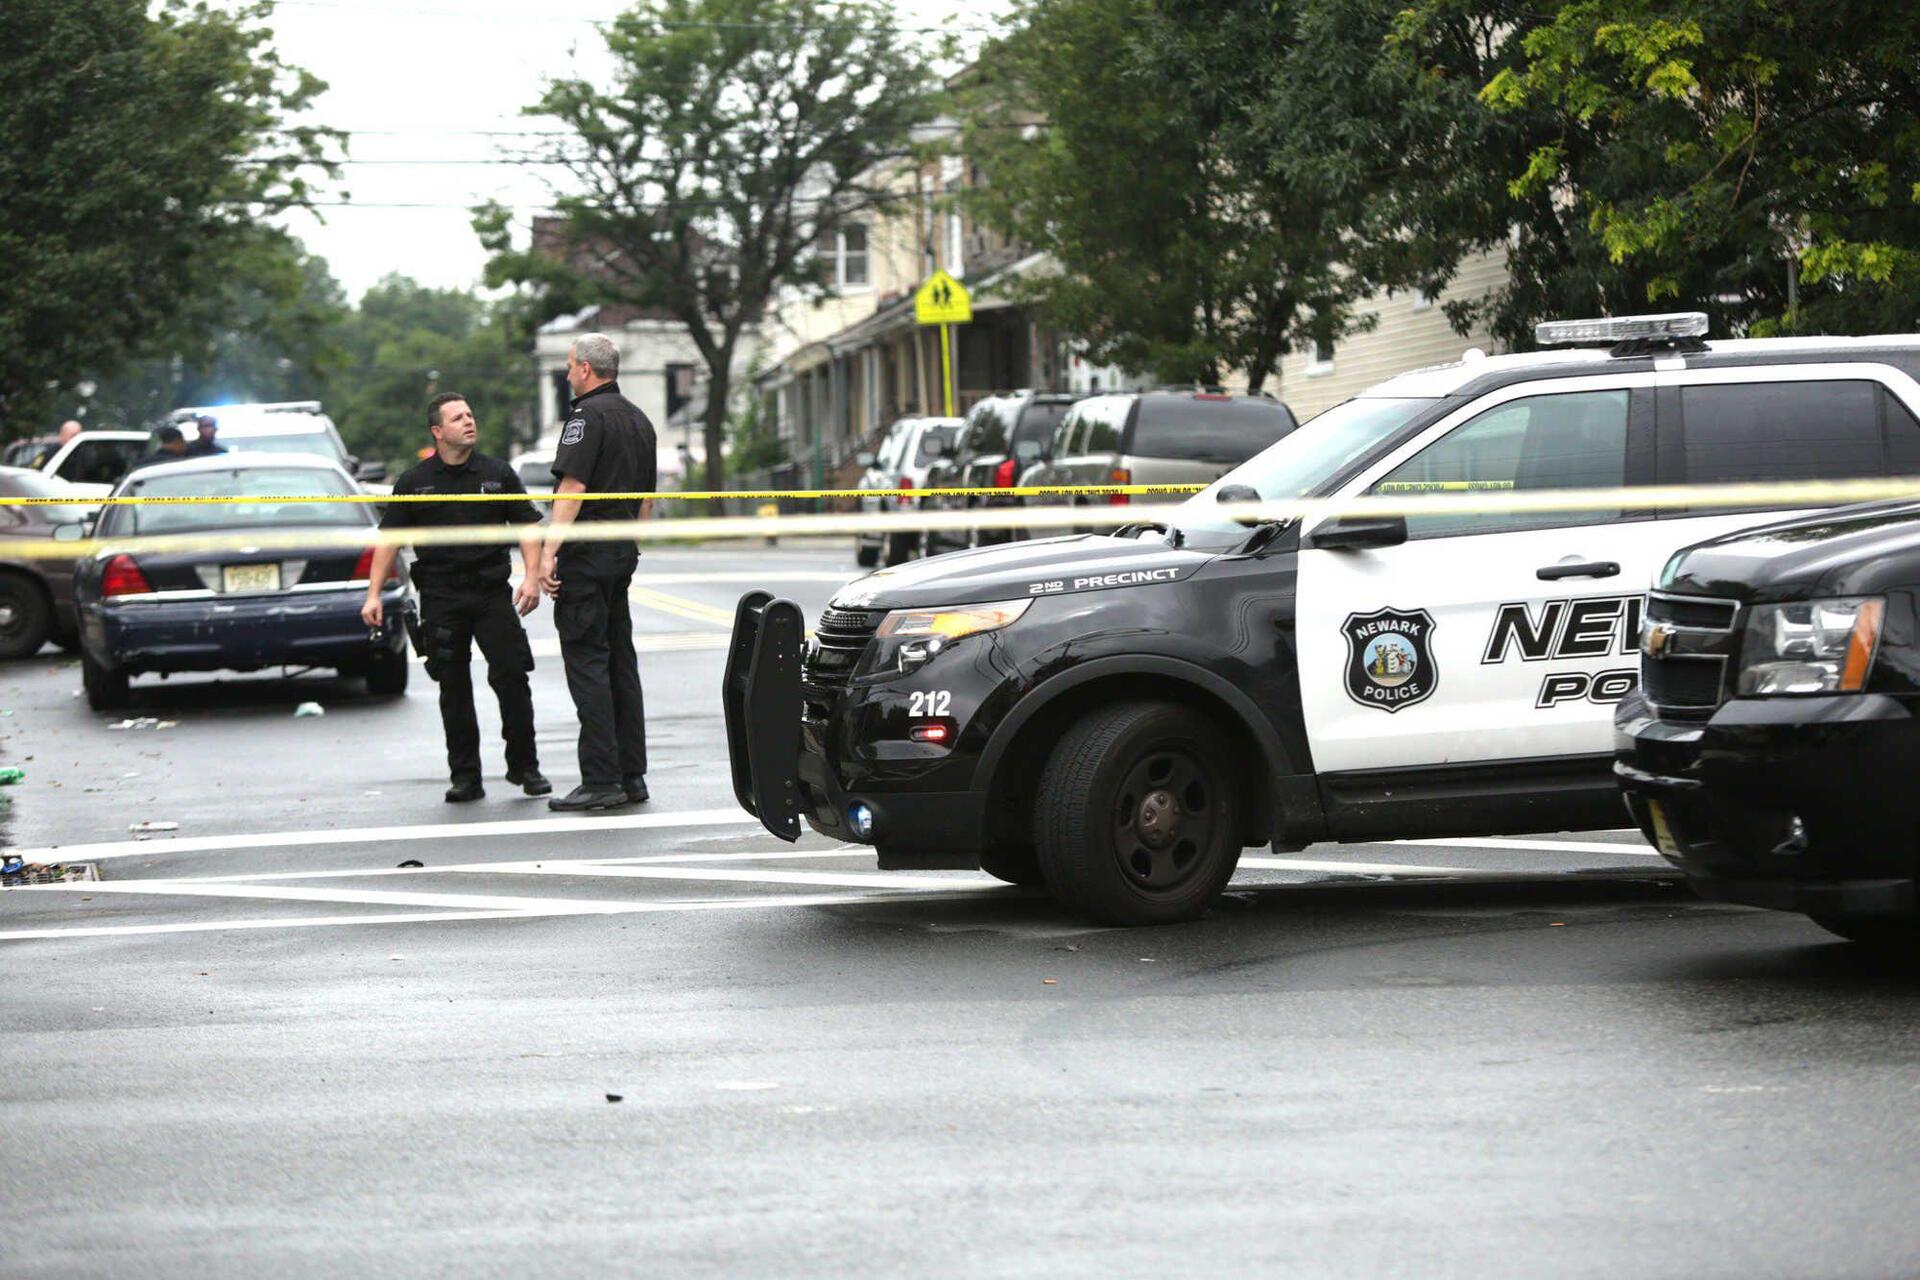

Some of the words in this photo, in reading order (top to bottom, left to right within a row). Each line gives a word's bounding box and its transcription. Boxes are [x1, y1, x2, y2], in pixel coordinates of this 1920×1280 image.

[1029, 580, 1064, 594] 2ND
[1074, 567, 1179, 589] PRECINCT
[1355, 619, 1421, 640] NEWARK
[908, 690, 952, 717] 212
[1363, 683, 1420, 700] POLICE
